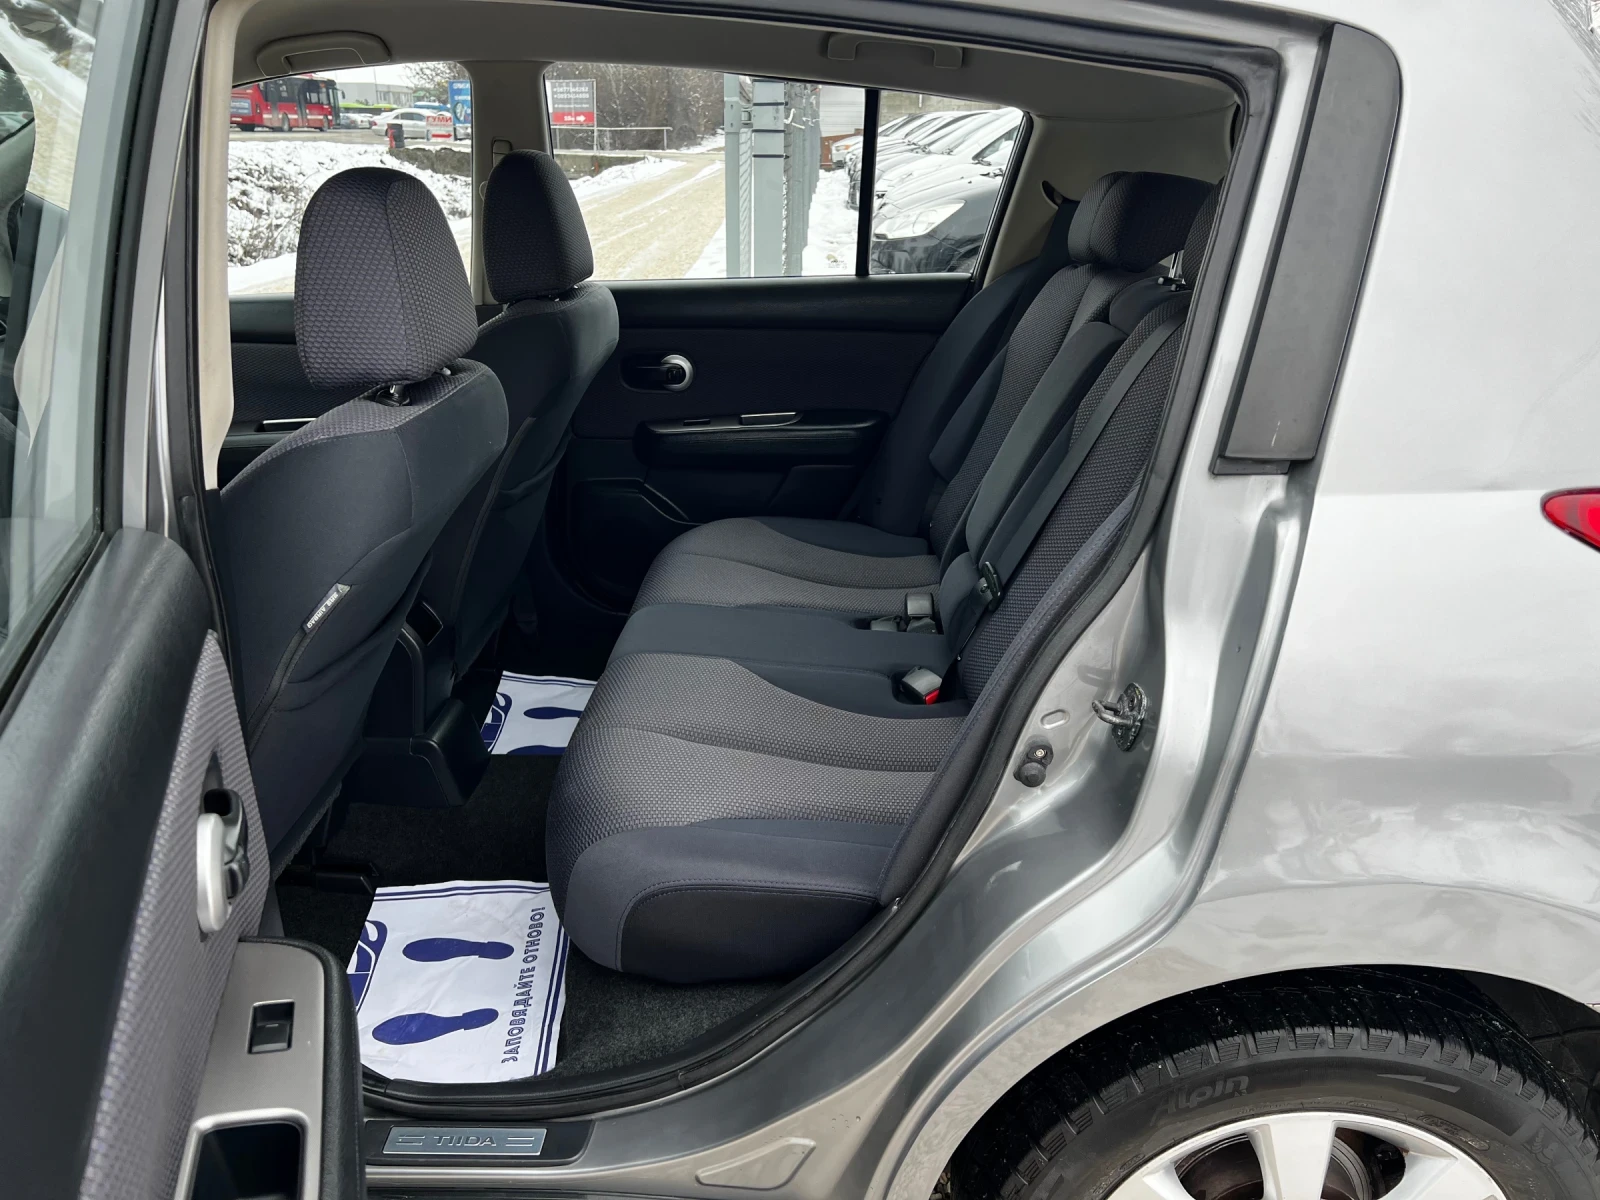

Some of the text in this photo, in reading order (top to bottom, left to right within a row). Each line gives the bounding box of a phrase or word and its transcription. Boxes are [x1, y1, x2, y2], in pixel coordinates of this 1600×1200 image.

[426, 115, 452, 123] ГУМИ
[306, 605, 326, 629] AIRBAG
[501, 906, 546, 1063] ЗАПОВЯДАЙТЕ ОТНОВО!
[433, 1135, 497, 1147] TIIDA
